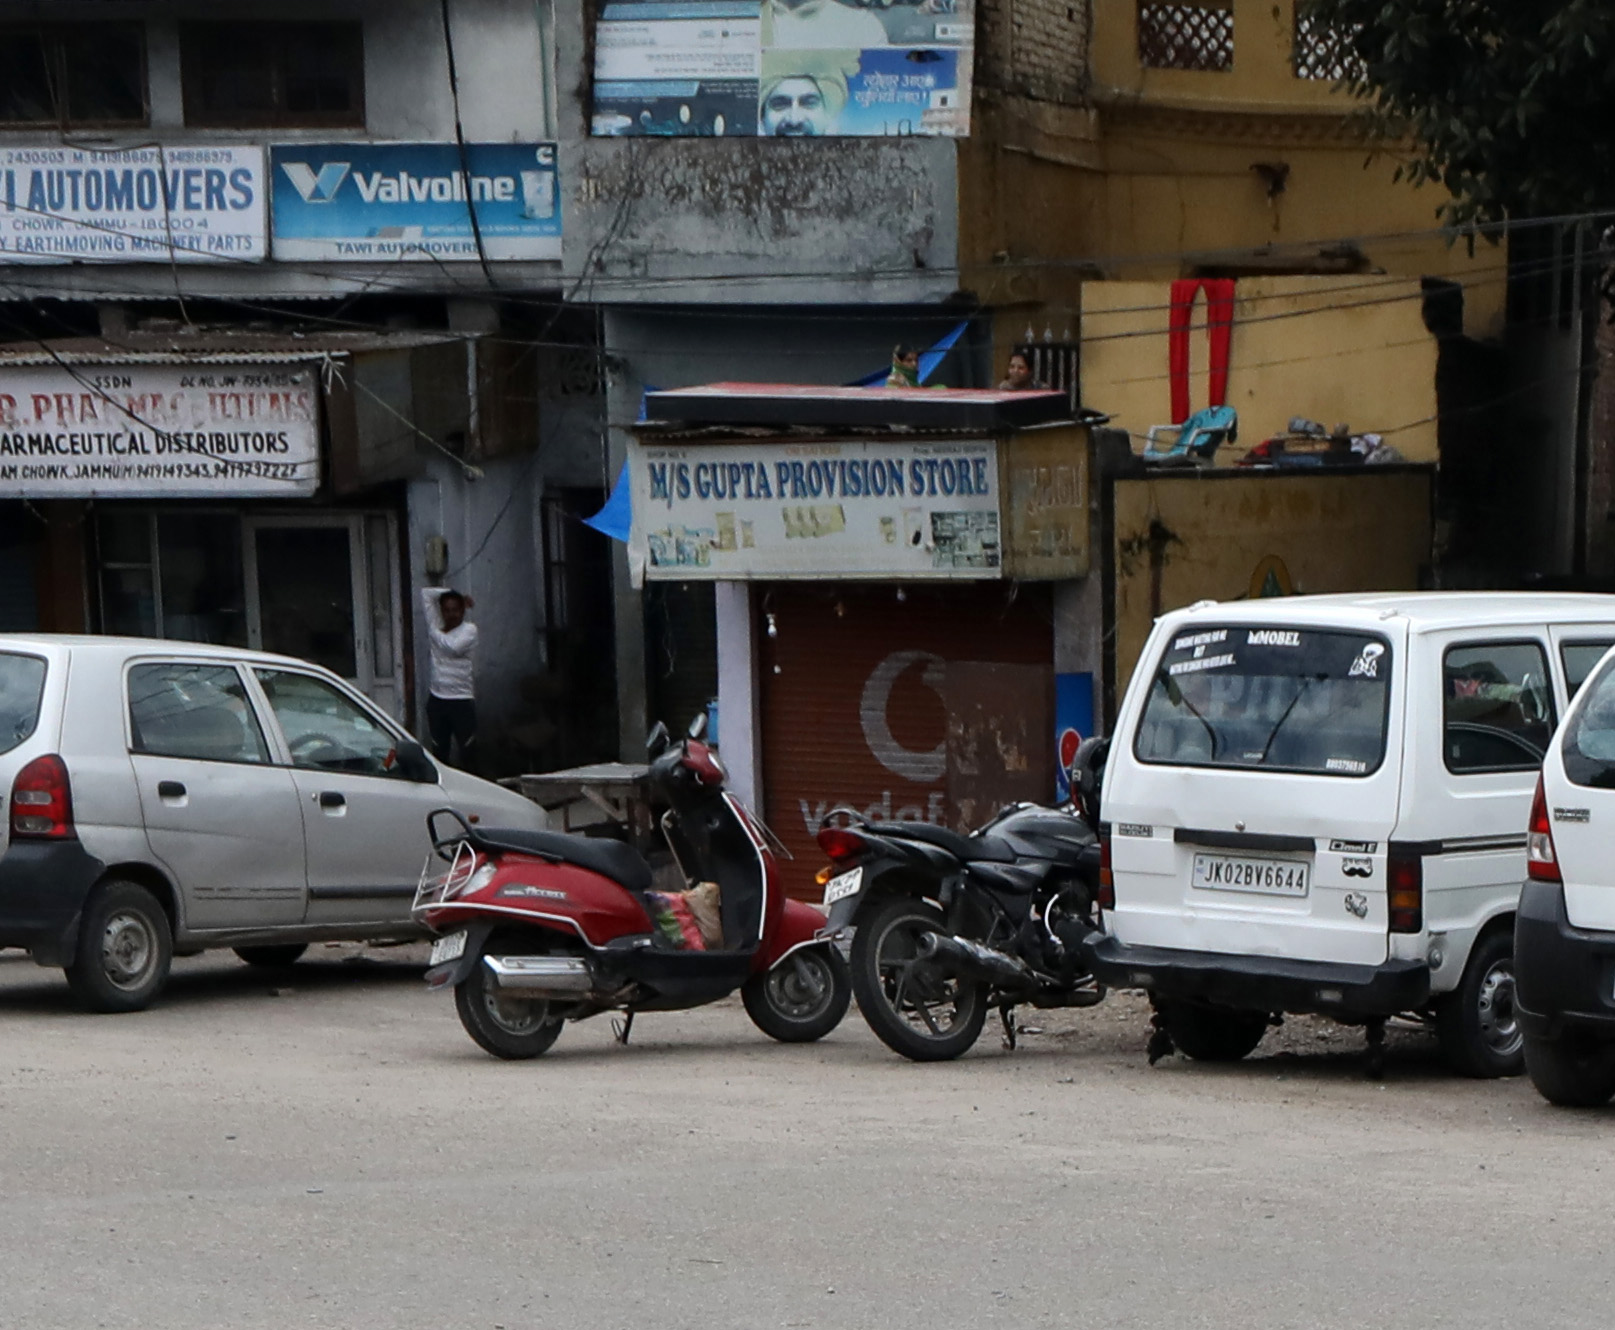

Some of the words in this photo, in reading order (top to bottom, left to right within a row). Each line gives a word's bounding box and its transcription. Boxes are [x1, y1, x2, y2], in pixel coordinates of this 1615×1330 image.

[27, 168, 254, 213] AUTOMOVERS
[352, 170, 515, 204] Valvoline
[12, 218, 64, 232] CHOWK
[15, 235, 126, 252] EARTHMOVING
[130, 234, 203, 252] MACHINERY
[207, 234, 253, 251] PARTS
[335, 240, 373, 256] TAWI
[380, 241, 480, 256] AUTOMOVERS
[155, 430, 290, 455] DISTRIBUTORS
[648, 461, 691, 510] M/S
[694, 461, 773, 501] GUPTA
[774, 457, 906, 501] PROVISION
[909, 456, 990, 498] STORE
[1204, 860, 1305, 891] JK02BV6644
